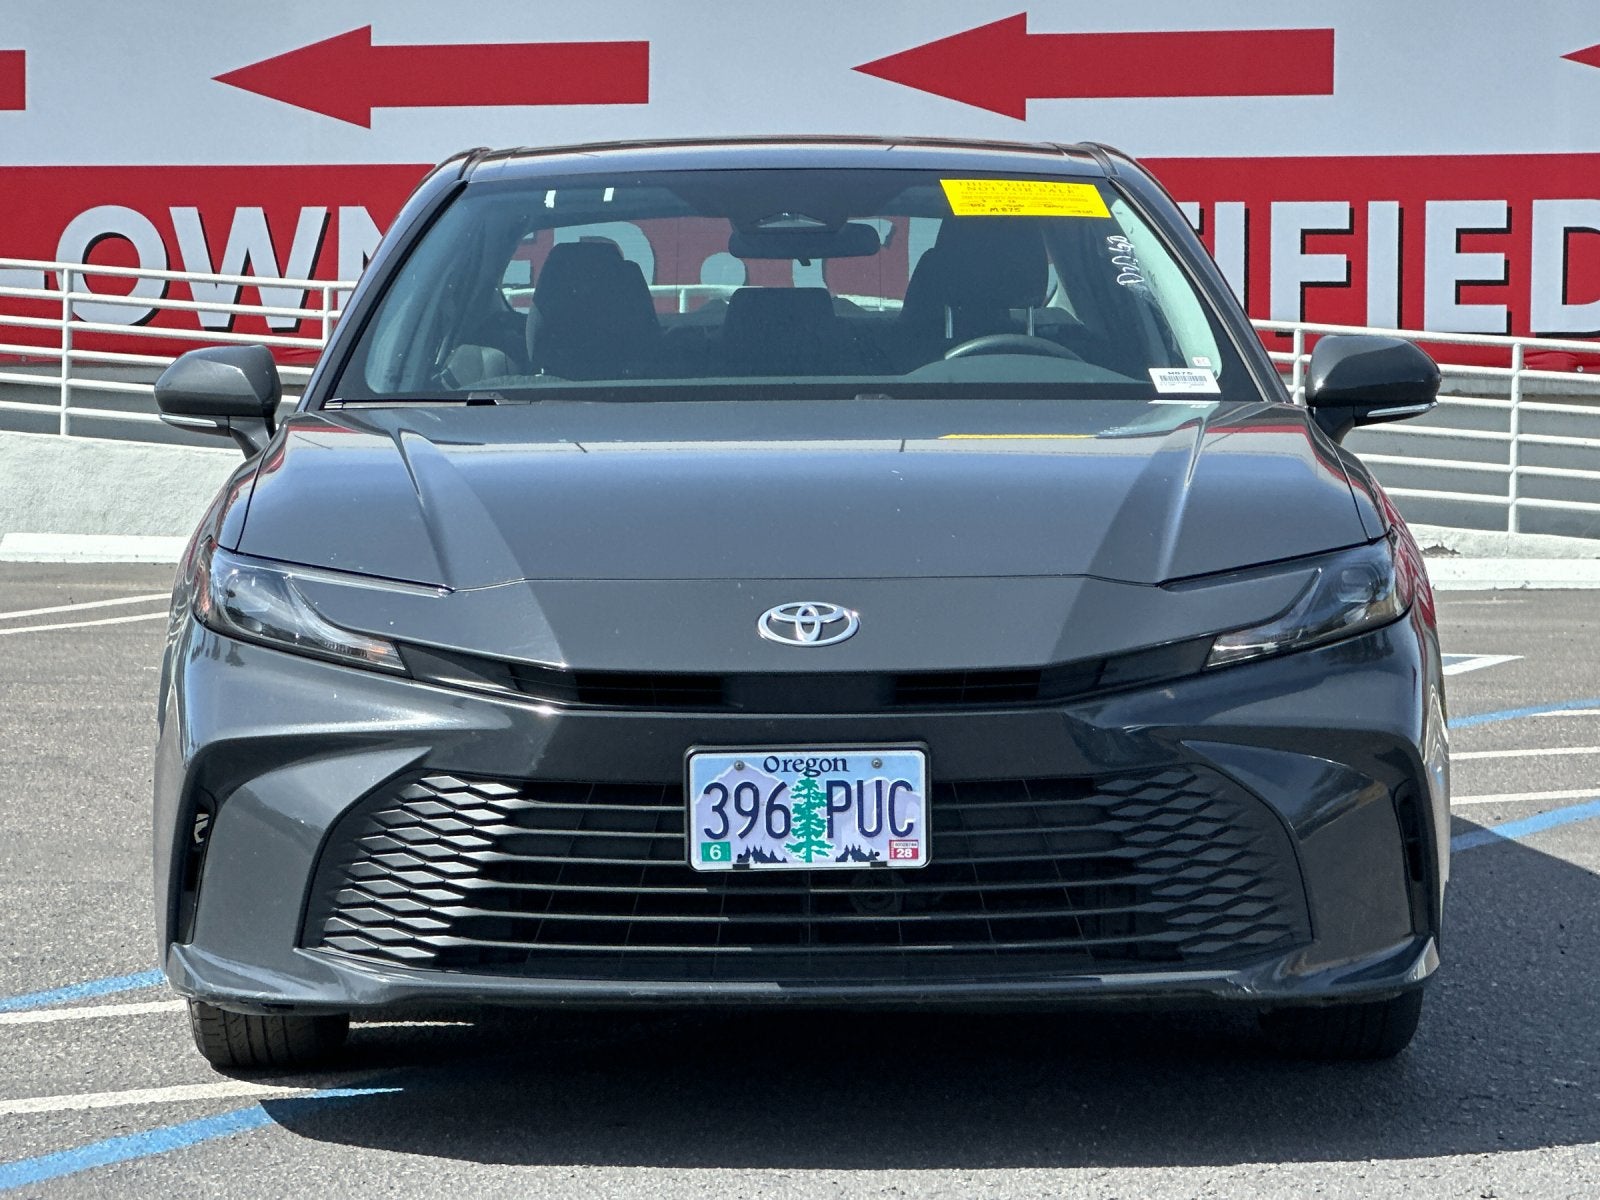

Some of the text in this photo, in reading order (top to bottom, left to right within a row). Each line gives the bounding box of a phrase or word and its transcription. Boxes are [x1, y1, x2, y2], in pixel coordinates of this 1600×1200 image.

[1177, 199, 1600, 337] IFIED
[763, 755, 850, 778] Oregon
[703, 779, 914, 840] 396 PUC
[709, 845, 722, 860] 6
[895, 848, 913, 859] 28
